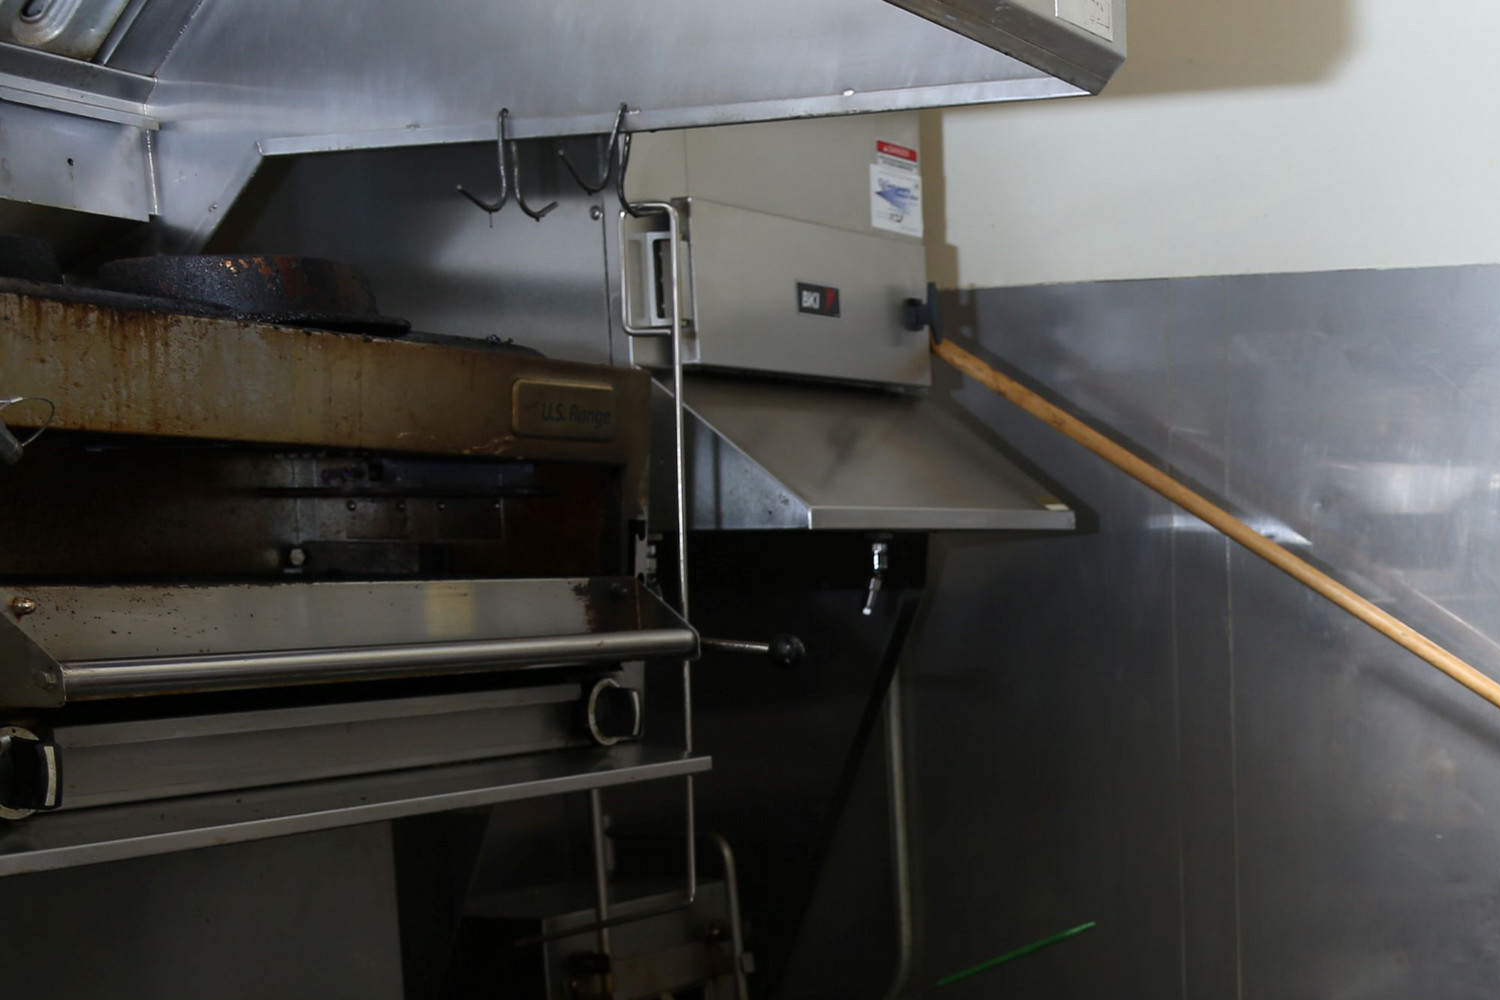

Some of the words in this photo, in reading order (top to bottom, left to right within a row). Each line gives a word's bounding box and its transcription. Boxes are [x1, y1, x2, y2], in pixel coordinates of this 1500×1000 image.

[802, 290, 820, 309] BKI
[541, 402, 564, 421] U.S.
[569, 403, 611, 428] Range
